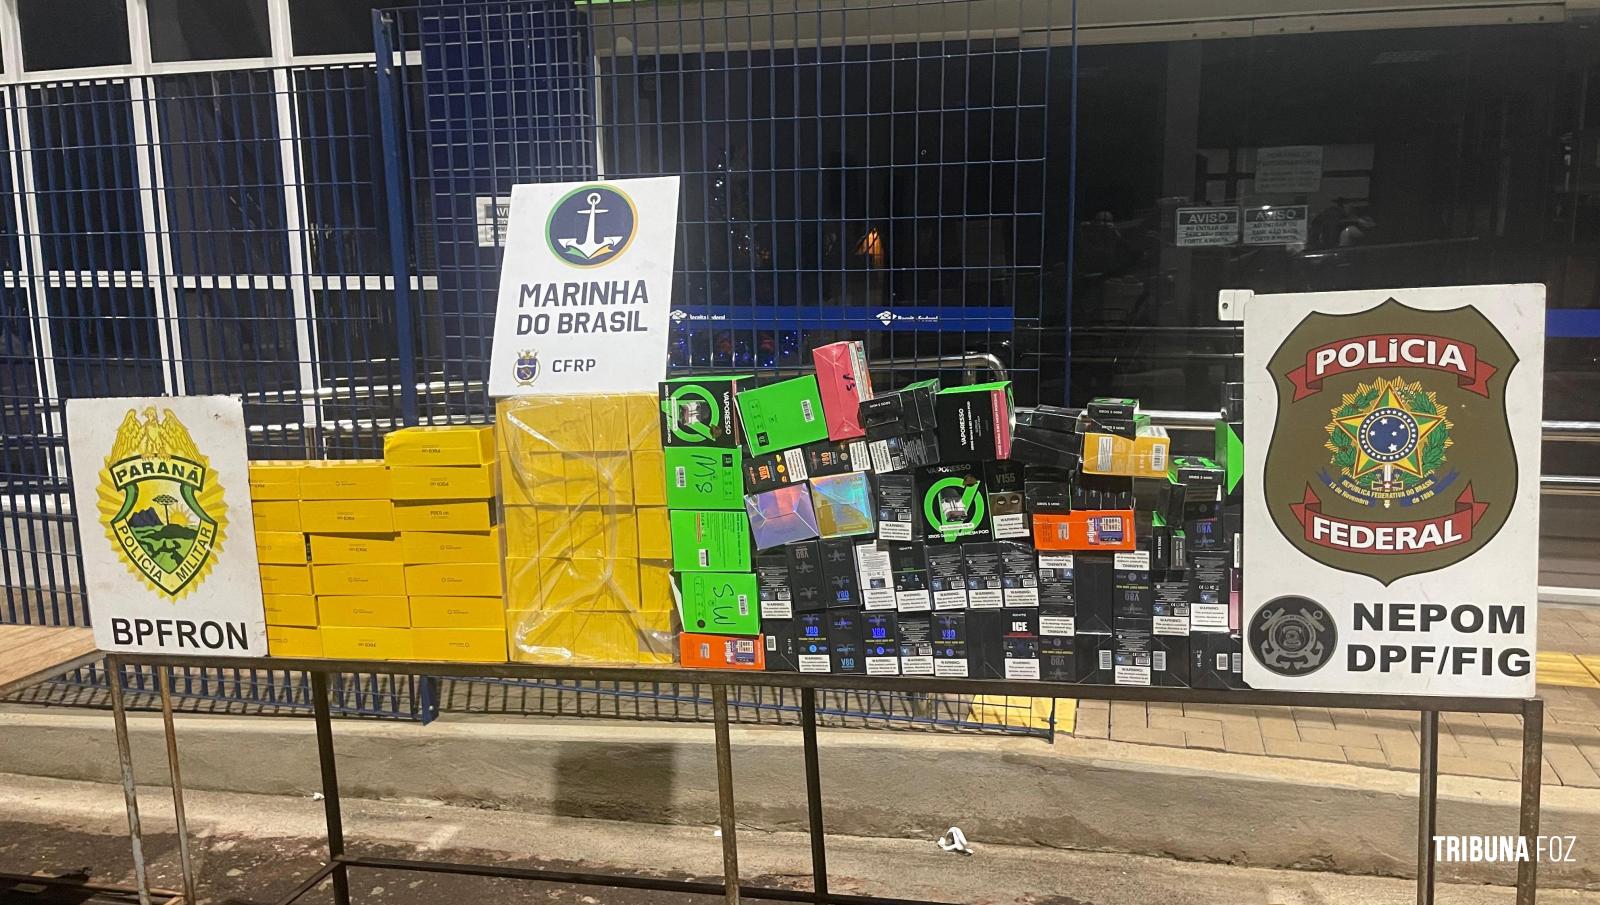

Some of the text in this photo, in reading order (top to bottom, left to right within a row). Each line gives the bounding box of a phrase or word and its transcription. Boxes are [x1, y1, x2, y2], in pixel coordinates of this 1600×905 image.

[1188, 213, 1228, 224] AVISO
[1256, 210, 1296, 220] AVISO
[519, 280, 649, 308] MARINHA
[517, 311, 648, 335] DO BRASIL
[552, 359, 596, 372] CFRP
[116, 462, 199, 483] PARANÁ
[995, 473, 1016, 484] V155
[1415, 479, 1434, 493] BRASIL
[1086, 518, 1096, 543] adjust
[1314, 516, 1462, 550] FEDERAL
[176, 527, 213, 582] MILITAR
[836, 591, 849, 600] V80
[1353, 602, 1525, 634] NEPOM
[805, 626, 818, 636] V80
[872, 628, 885, 638] V80
[1012, 622, 1028, 631] ICE
[112, 618, 248, 650] BPFRON
[942, 630, 956, 639] V80
[724, 641, 734, 663] adjust
[841, 658, 854, 668] V80
[1346, 644, 1530, 677] DPF/FIG
